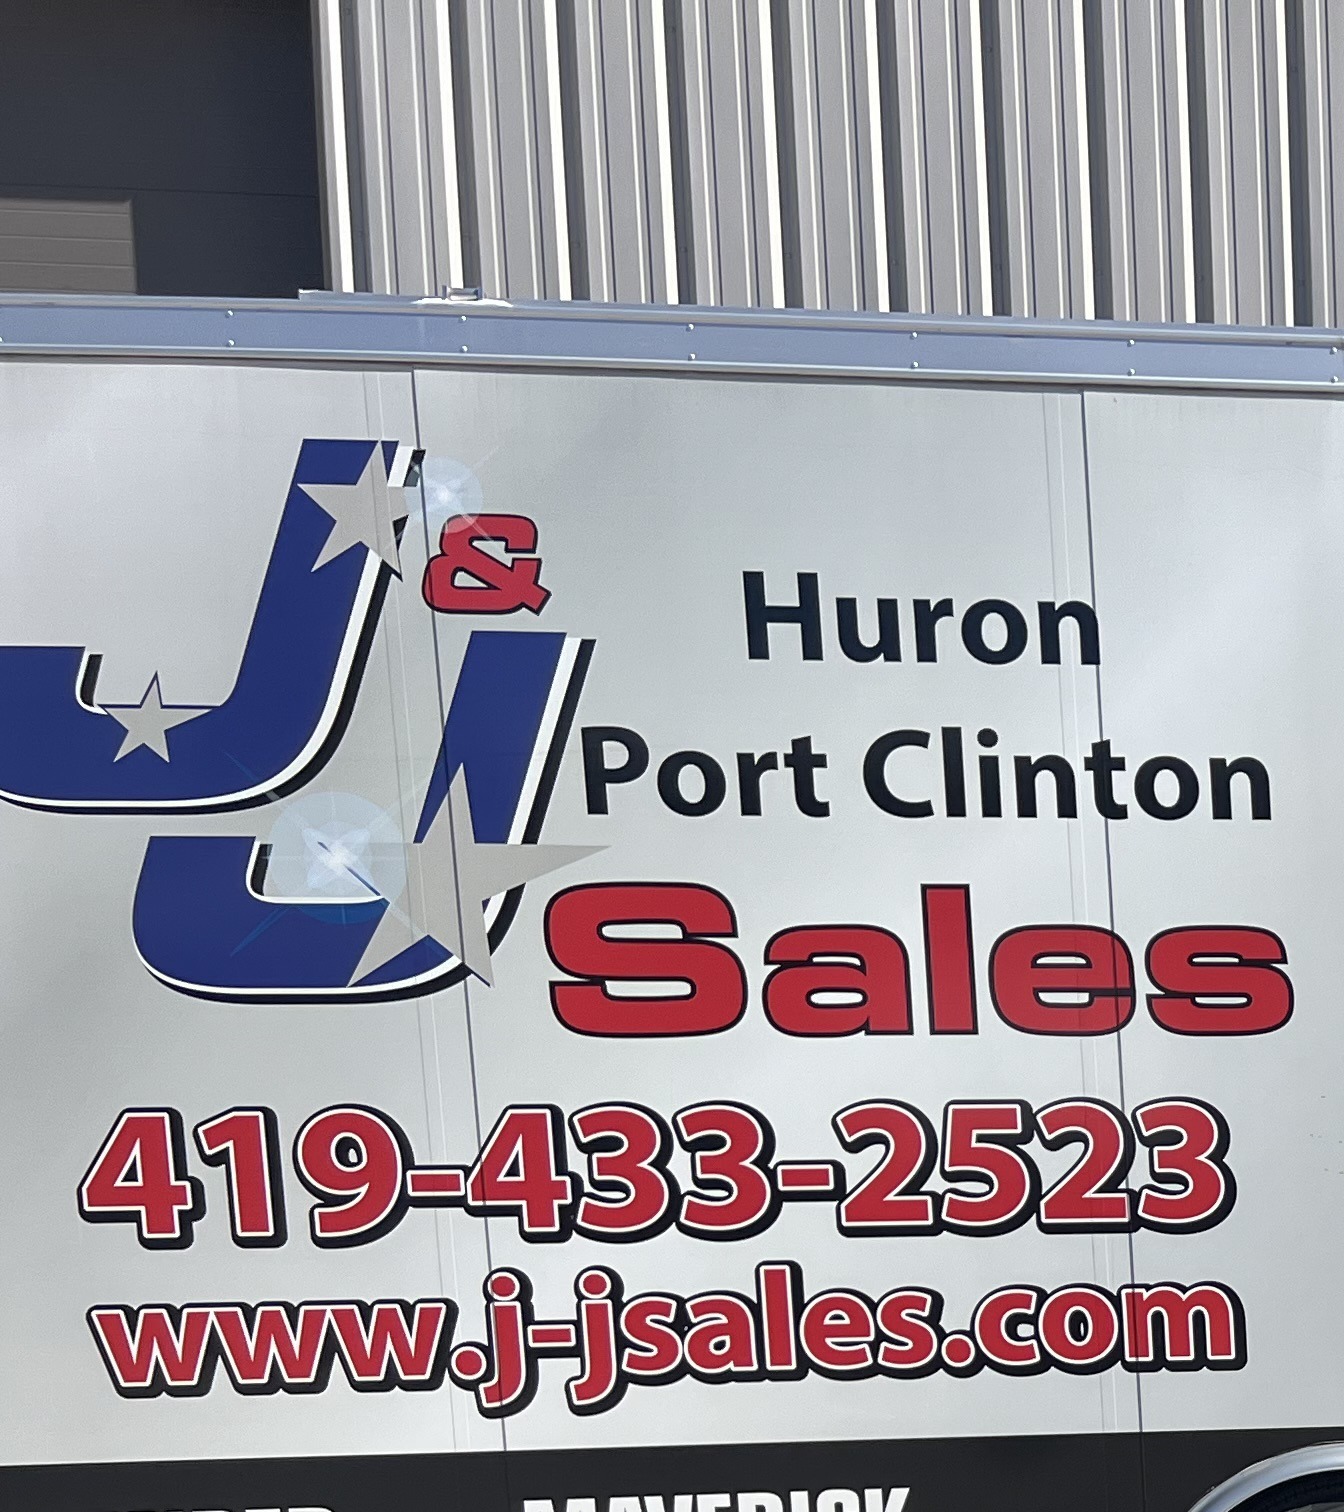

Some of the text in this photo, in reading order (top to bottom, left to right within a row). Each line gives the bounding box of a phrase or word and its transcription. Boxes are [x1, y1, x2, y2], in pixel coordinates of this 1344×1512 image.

[743, 570, 1101, 666] Huron
[581, 727, 1272, 821] Port Clinton
[544, 882, 1294, 1039] Sales
[78, 1097, 1237, 1250] 419-433-2523
[87, 1260, 1248, 1419] www.j-jsales.com
